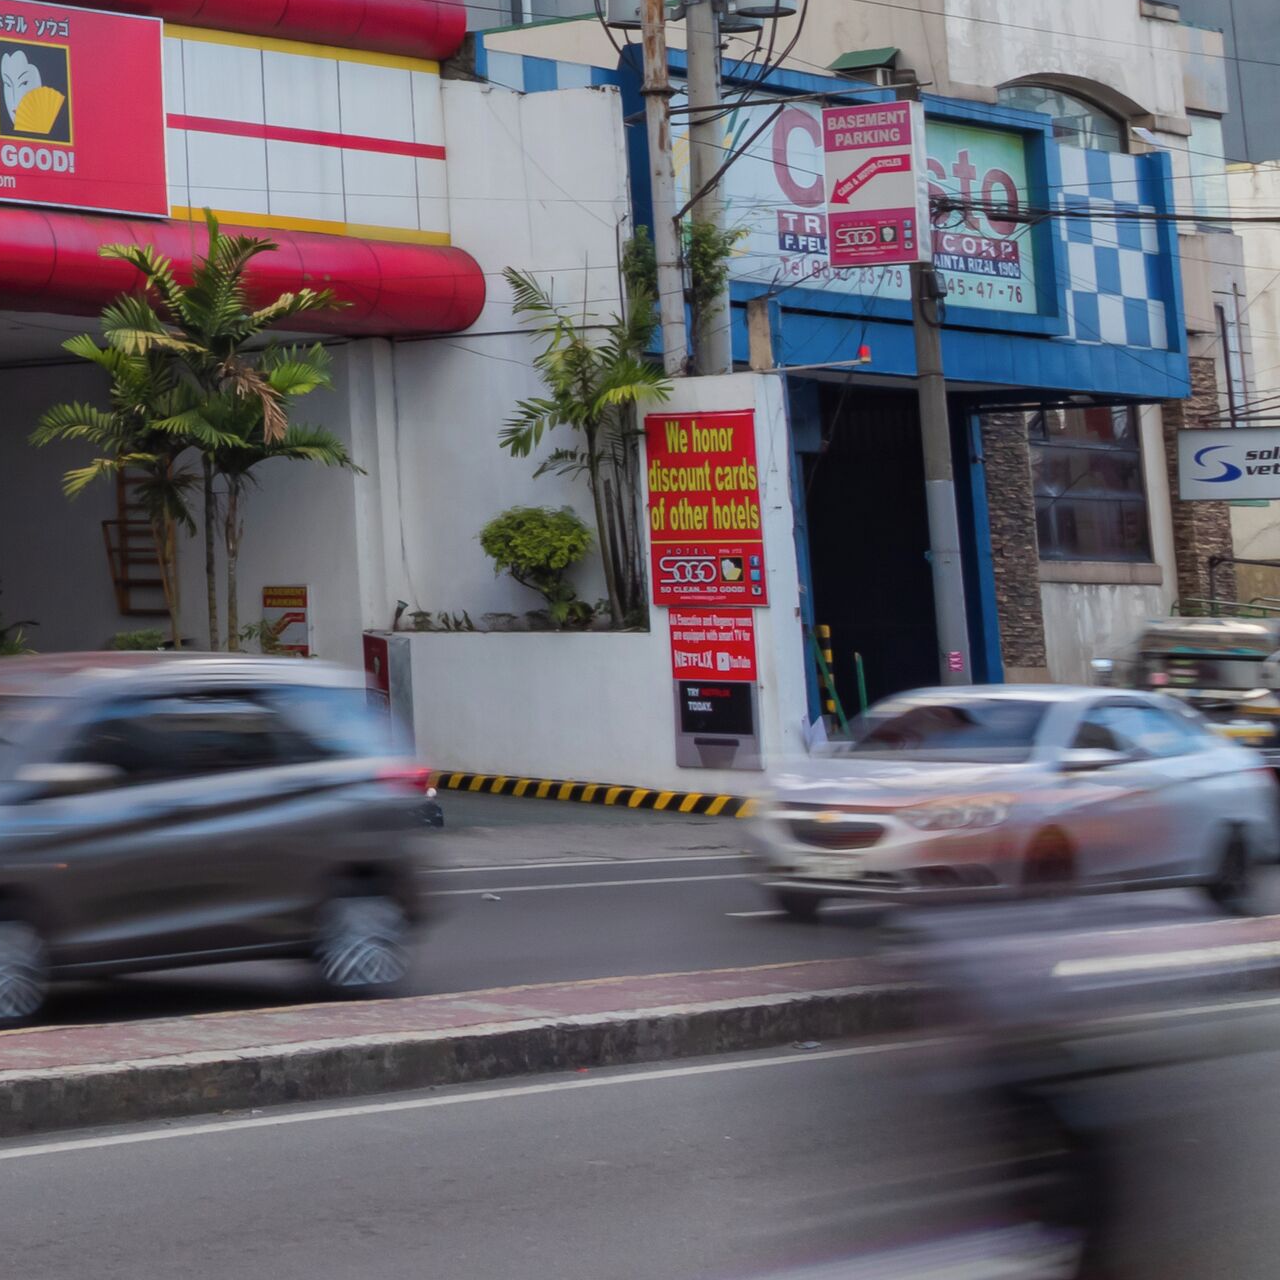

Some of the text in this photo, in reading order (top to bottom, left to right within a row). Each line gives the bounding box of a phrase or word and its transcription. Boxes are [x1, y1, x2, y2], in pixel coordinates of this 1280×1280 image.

[34, 17, 70, 38] ソウゴ
[827, 110, 907, 130] BASEMENT
[835, 128, 901, 147] PARKING
[0, 144, 75, 174] GOOD!
[933, 254, 965, 270] AINTA
[967, 257, 997, 275] RIZAL
[947, 278, 1023, 303] 45-47-76
[665, 420, 733, 454] We honor
[1245, 446, 1280, 460] sol
[648, 457, 757, 492] discount cards
[651, 494, 759, 531] of other hotels
[660, 556, 717, 583] SOGO
[674, 650, 713, 669] NETFLIX
